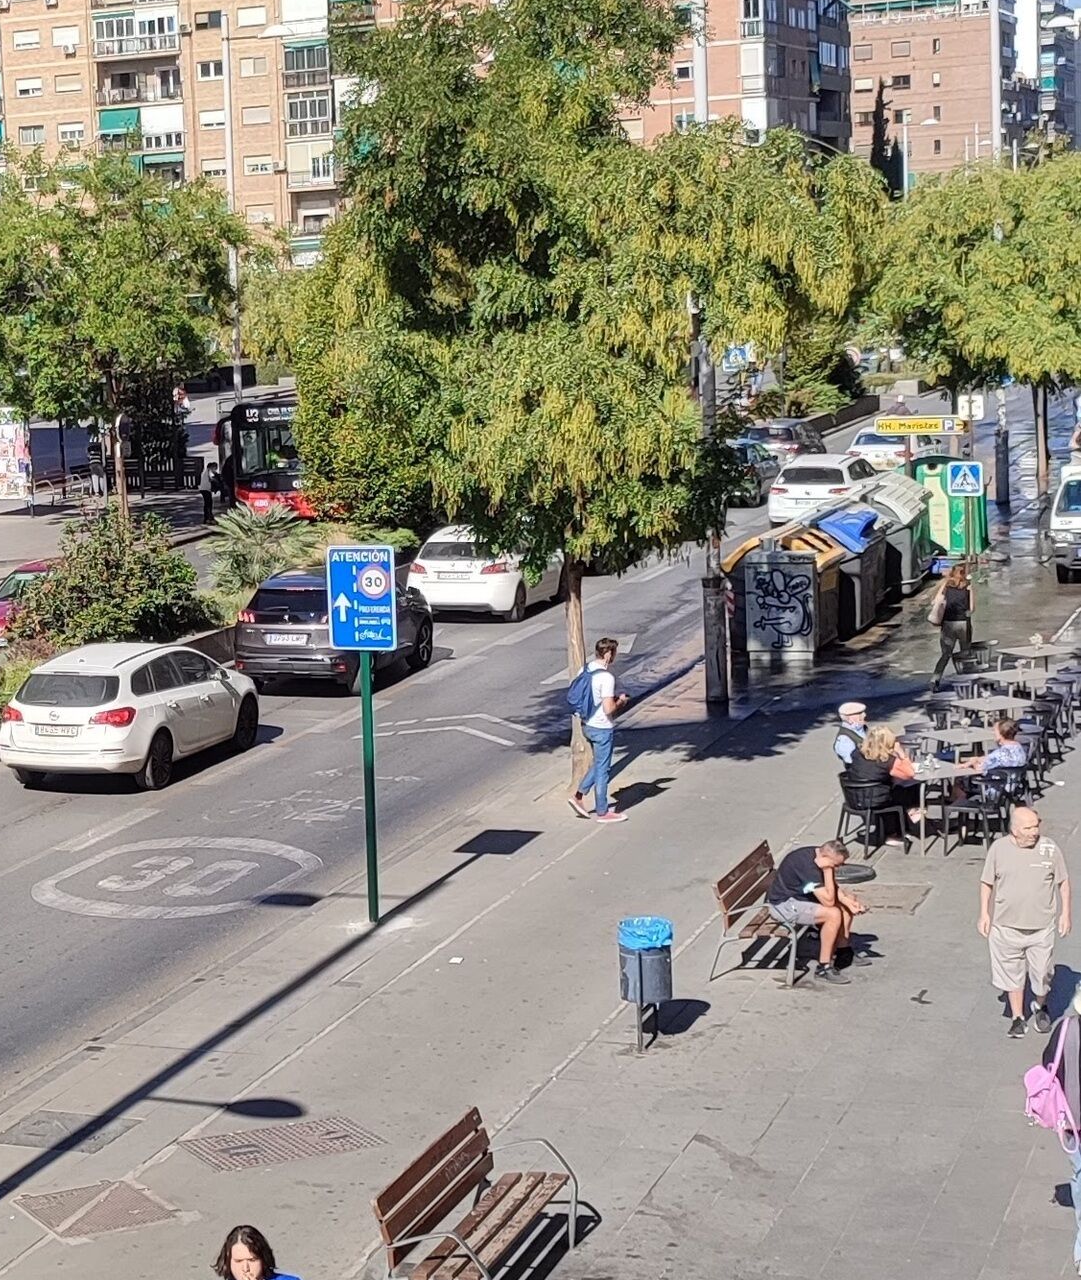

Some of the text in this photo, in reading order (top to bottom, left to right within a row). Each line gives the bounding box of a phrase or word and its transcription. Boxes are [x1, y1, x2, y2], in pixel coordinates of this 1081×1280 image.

[331, 549, 388, 562] ATENCIÓN
[365, 576, 382, 588] 30
[95, 855, 260, 897] 30
